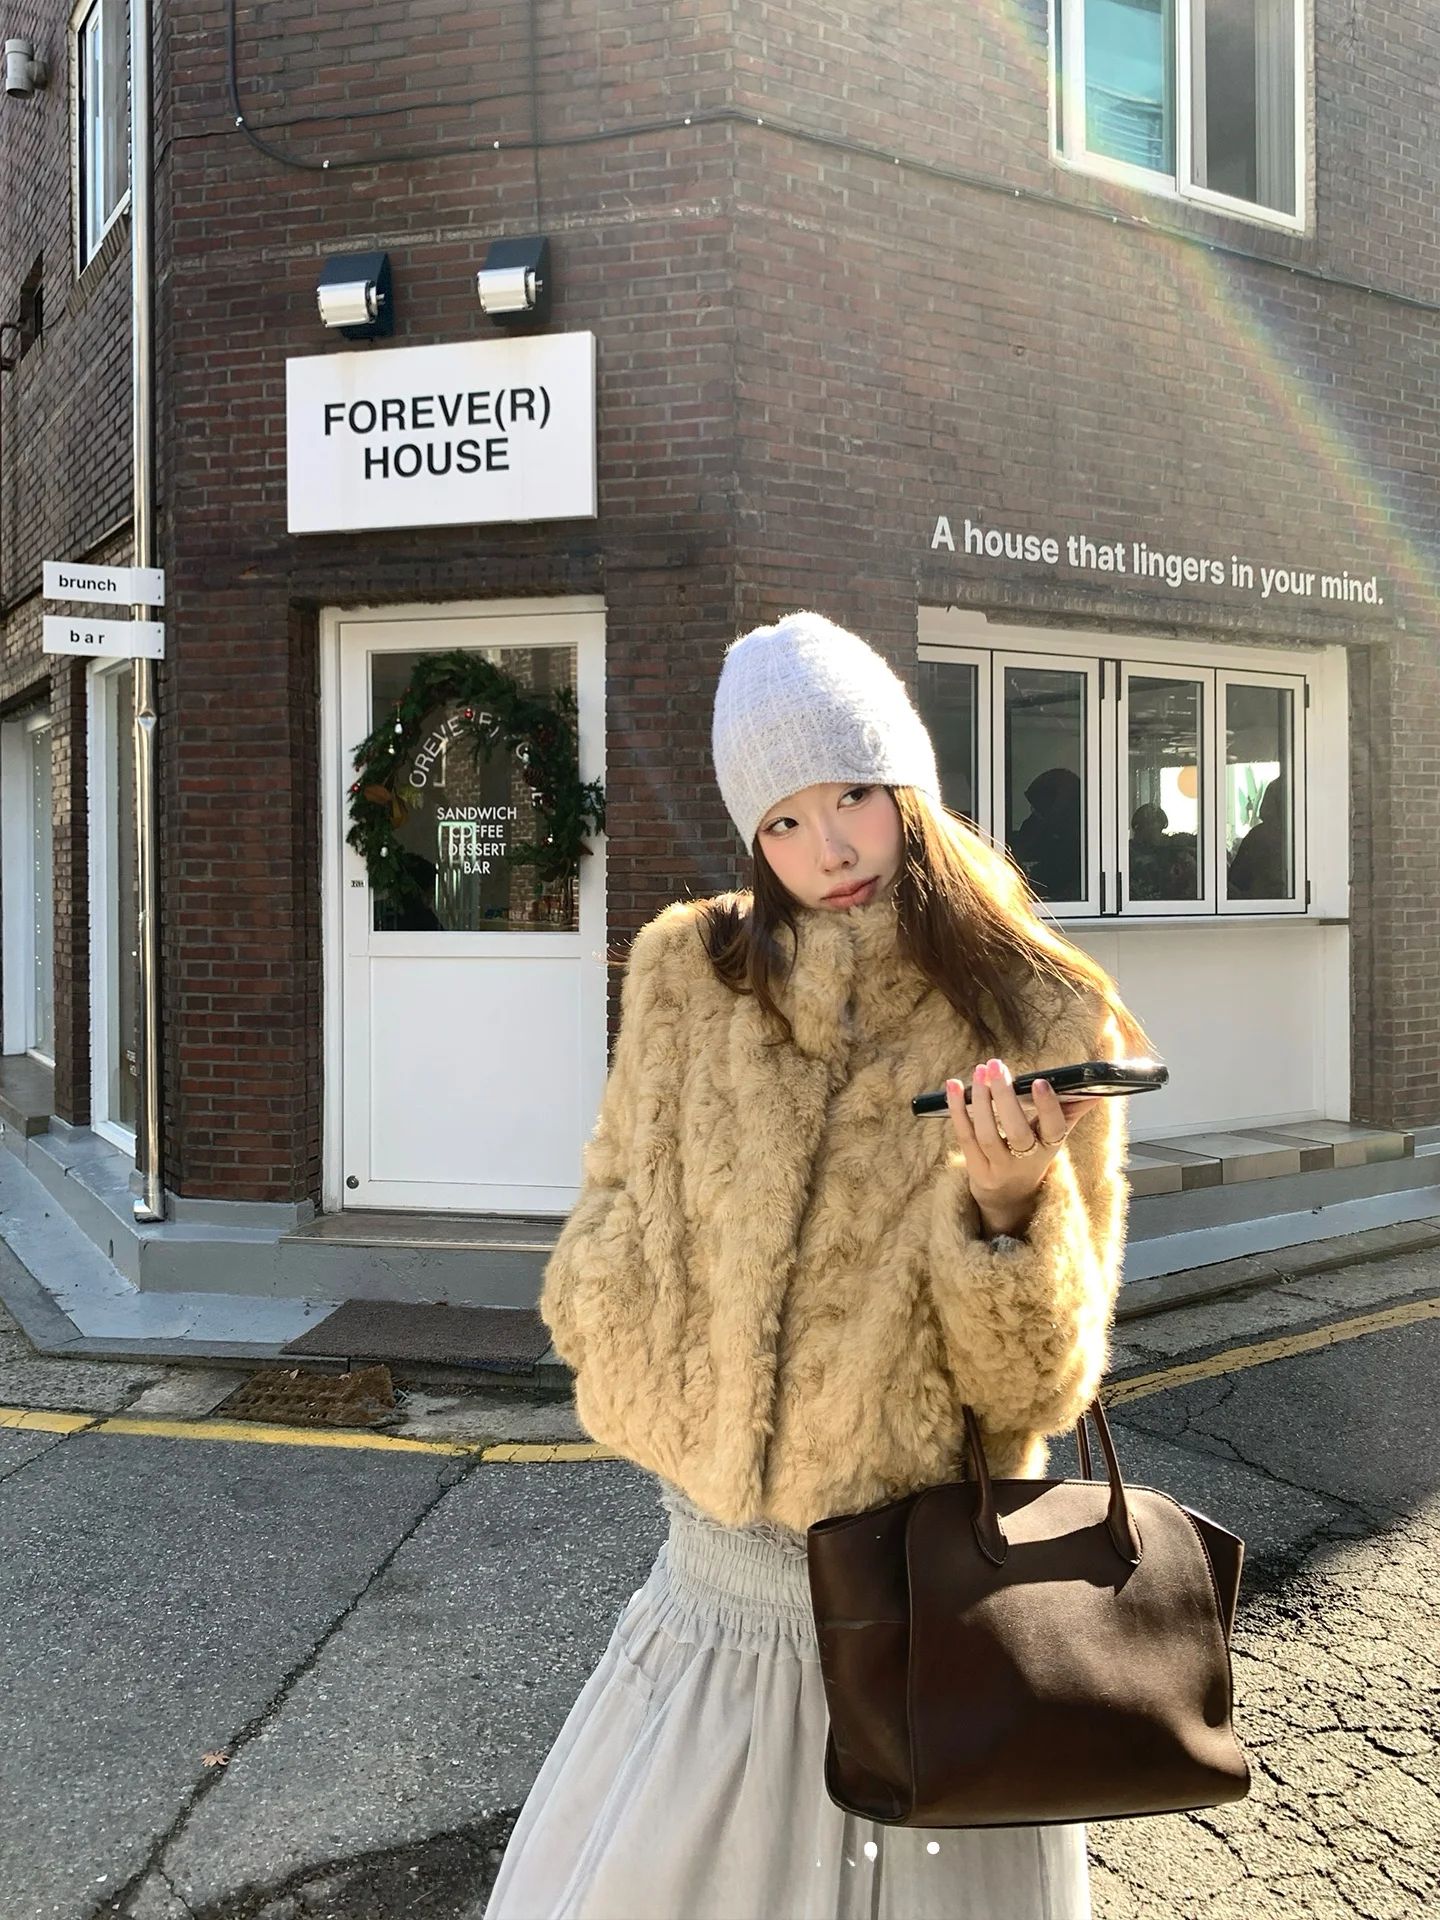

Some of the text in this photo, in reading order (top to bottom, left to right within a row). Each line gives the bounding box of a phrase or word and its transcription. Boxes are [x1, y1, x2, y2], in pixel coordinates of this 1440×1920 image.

[324, 386, 551, 436] FOREVE(R)
[364, 437, 510, 480] HOUSE
[931, 515, 1384, 605] A house that lingers in your mind.
[58, 574, 117, 592] brunch
[69, 629, 105, 644] bar
[437, 806, 517, 820] SANDWICH
[452, 824, 504, 838] COFFEE
[448, 843, 507, 856] DESSERT
[463, 860, 491, 874] BAR
